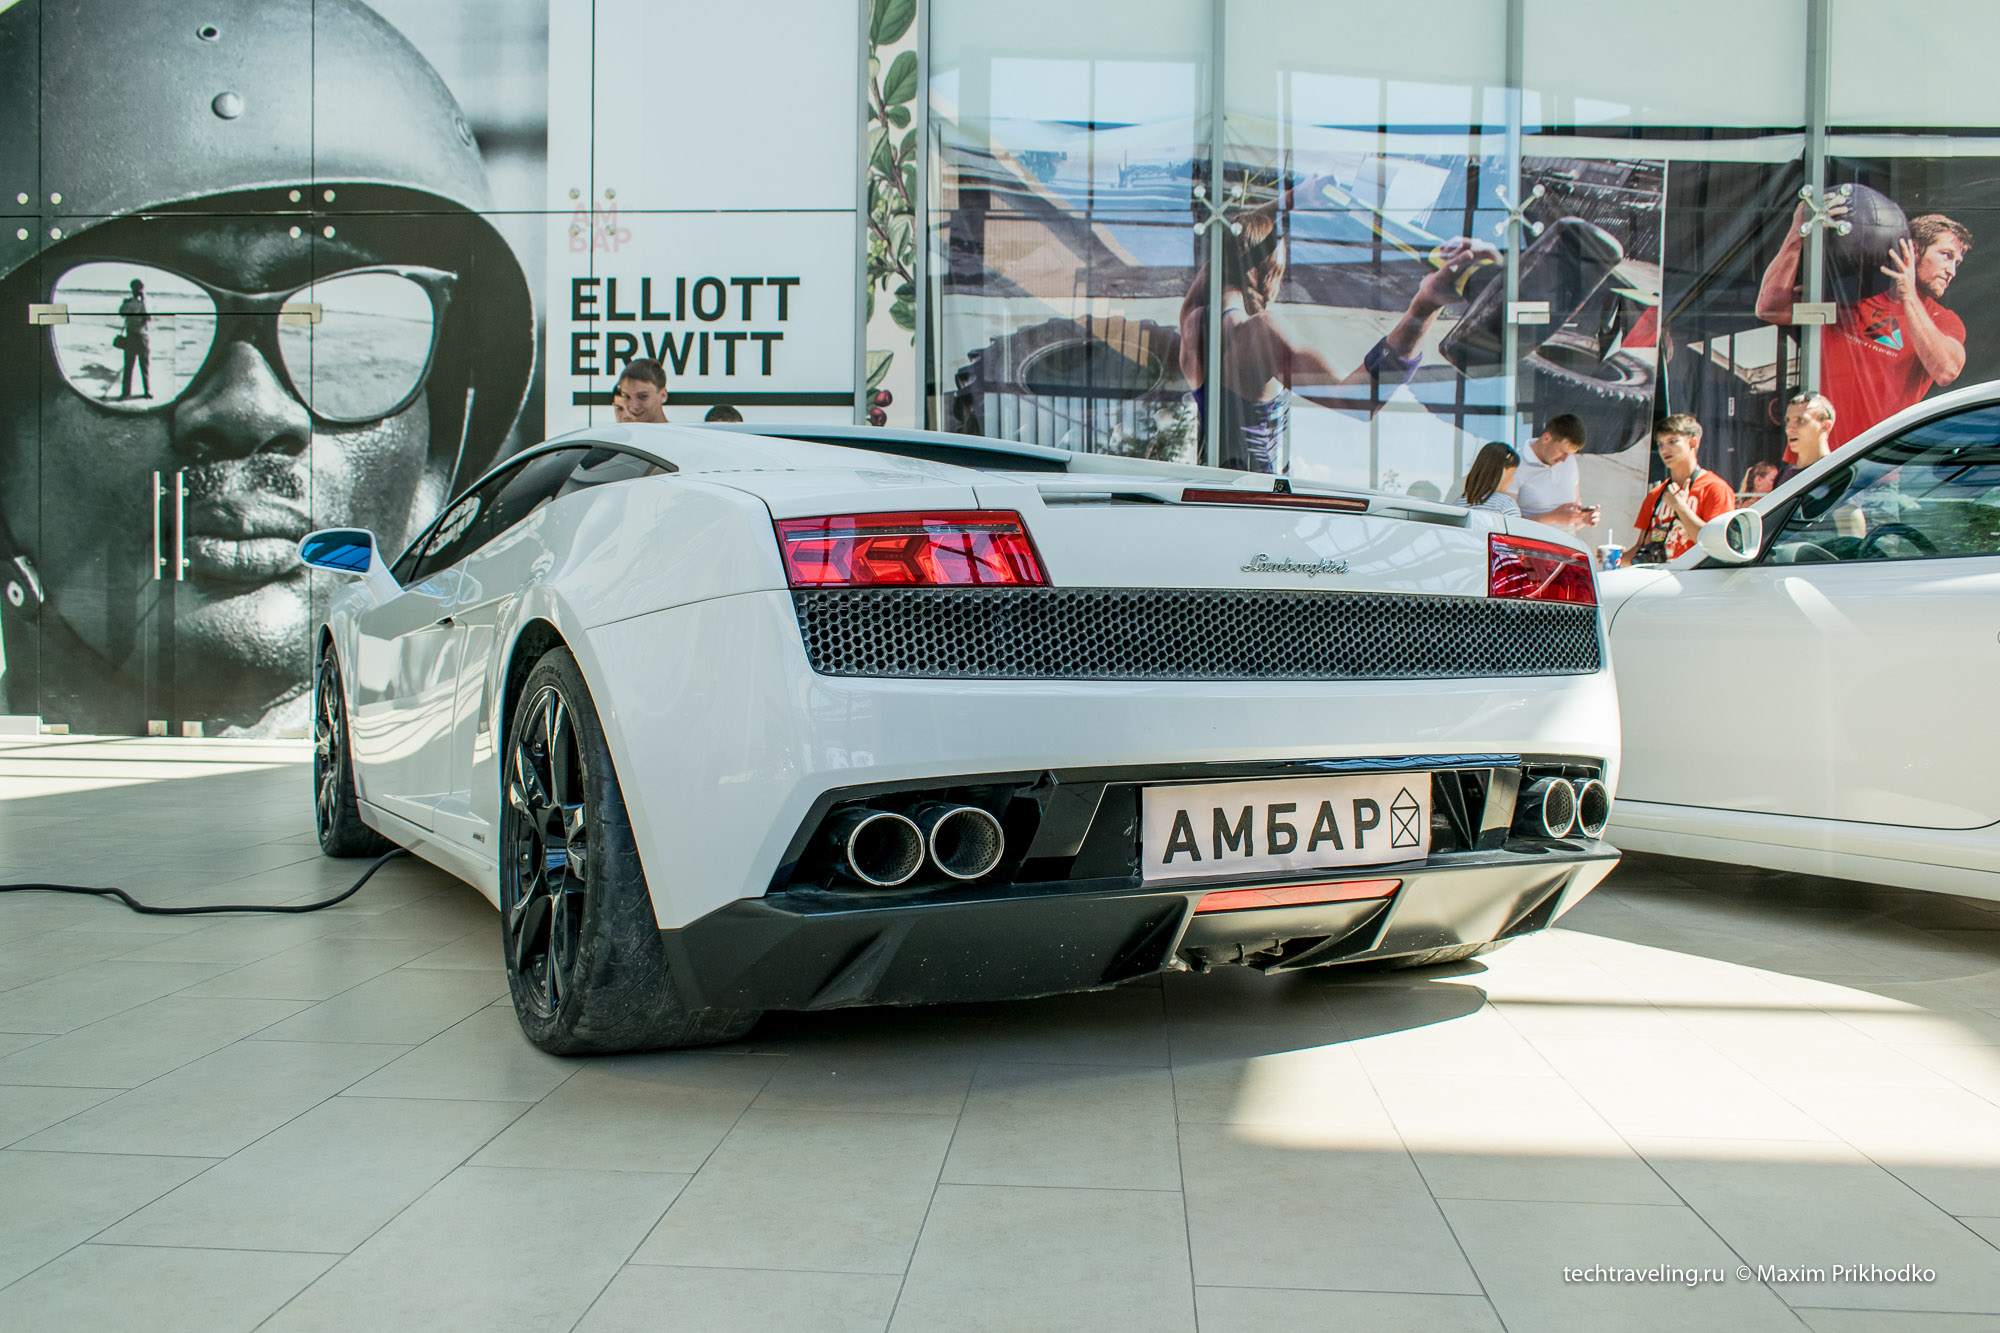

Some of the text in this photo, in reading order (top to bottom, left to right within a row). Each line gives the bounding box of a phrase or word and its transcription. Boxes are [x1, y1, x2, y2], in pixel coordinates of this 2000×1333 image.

[571, 277, 800, 321] ELLIOTT
[571, 332, 784, 376] ERWITT
[1241, 553, 1350, 578] Lamborghini
[1162, 798, 1381, 864] АМБАР
